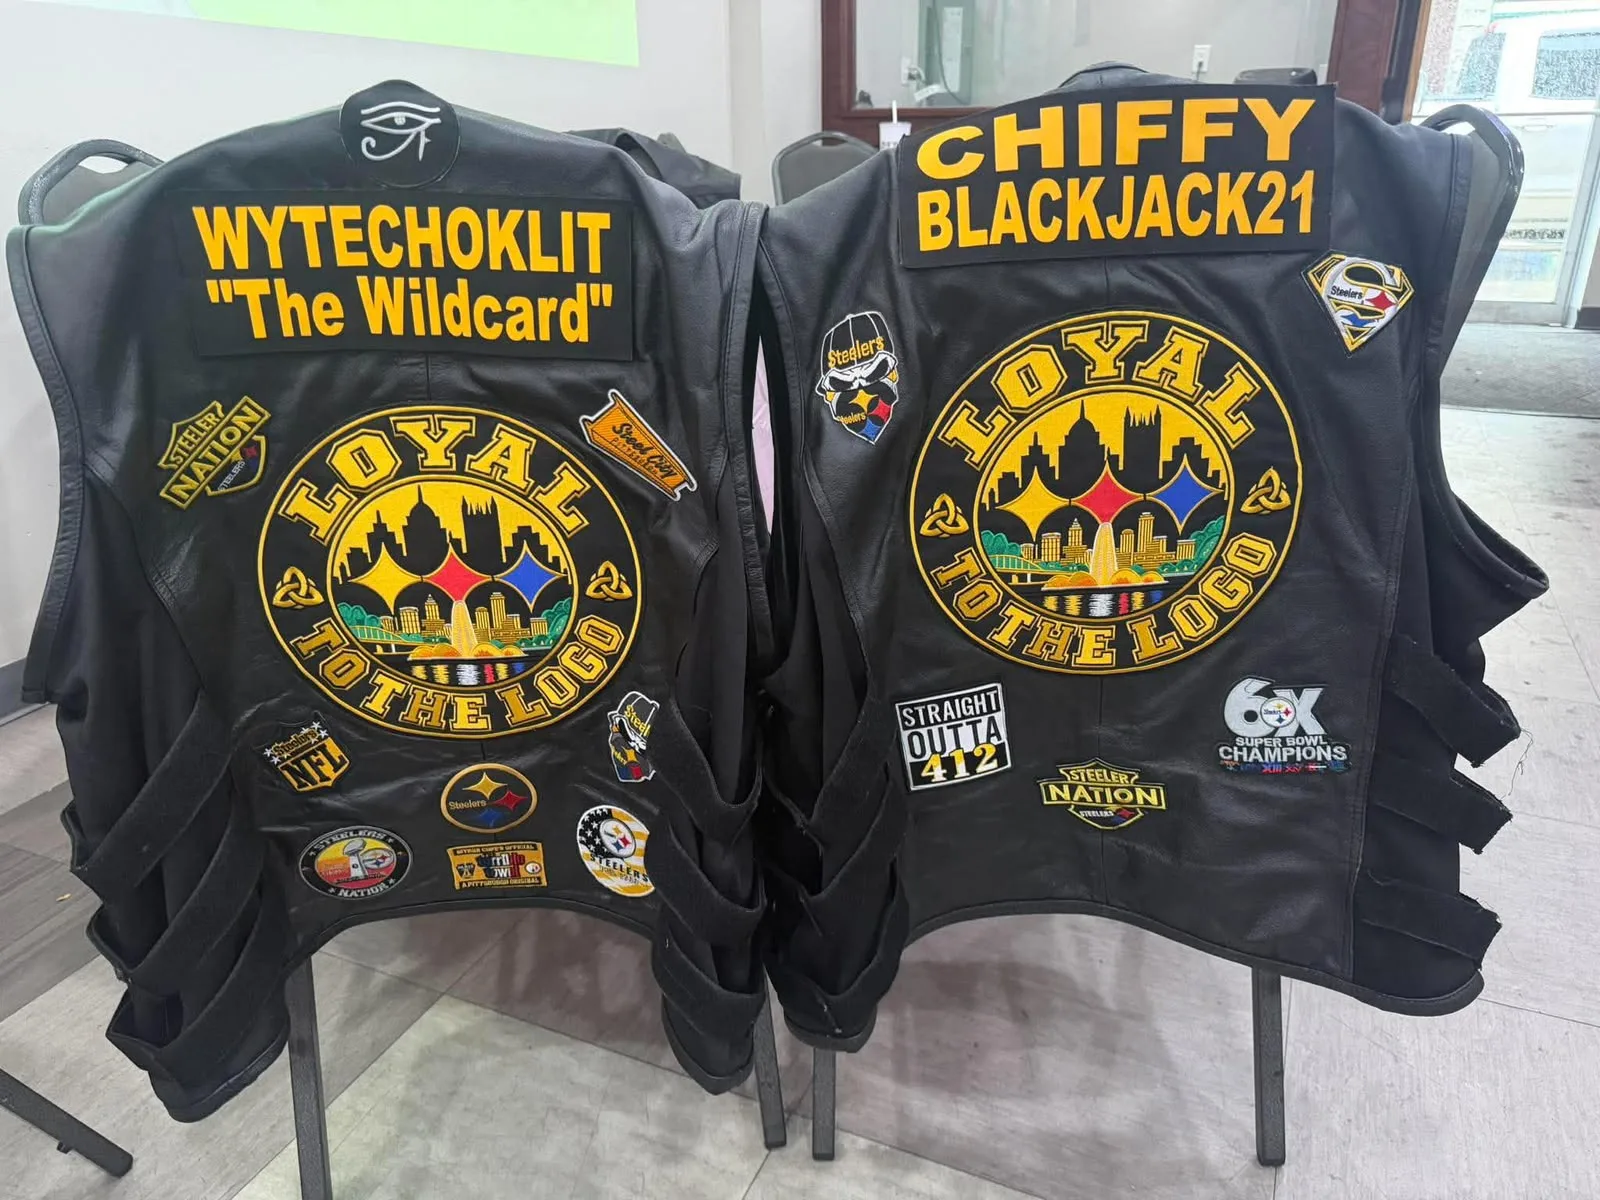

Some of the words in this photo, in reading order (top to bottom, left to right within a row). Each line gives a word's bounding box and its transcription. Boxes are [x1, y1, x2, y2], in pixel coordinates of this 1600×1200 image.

[917, 98, 1316, 180] CHIFFY
[918, 170, 1315, 252] BLACKJACK21
[192, 204, 611, 274] WYTECHOKLIT
[206, 278, 345, 339] "The
[356, 275, 613, 343] Wildcard"
[1330, 285, 1363, 300] Steelers
[827, 335, 886, 369] Steelers
[936, 319, 1261, 471] LOYAL
[169, 412, 221, 465] STEELER
[169, 404, 262, 501] NATION
[611, 422, 656, 455] Steel
[217, 460, 246, 491] STEELERS
[278, 413, 592, 546] LOYAL
[930, 547, 1003, 622] TO
[987, 598, 1116, 668] THE
[1127, 531, 1277, 665] LOGO
[289, 618, 371, 691] TO
[361, 670, 493, 732] THE
[499, 614, 625, 728] LOGO
[901, 689, 998, 728] STRAIGHT
[907, 715, 1003, 760] OUTTA
[1218, 745, 1348, 763] CHAMPIONS
[1235, 736, 1283, 748] SUPER
[1286, 735, 1328, 747] BOWL
[280, 737, 350, 792] NFL
[920, 743, 999, 783] 412
[1069, 768, 1129, 784] STEELER
[448, 799, 488, 811] Steelers
[1048, 784, 1159, 806] NATION
[1079, 810, 1115, 818] STEELERS
[313, 829, 388, 851] STEELERS
[589, 852, 649, 882] STEELERS
[337, 882, 390, 898] NATION
